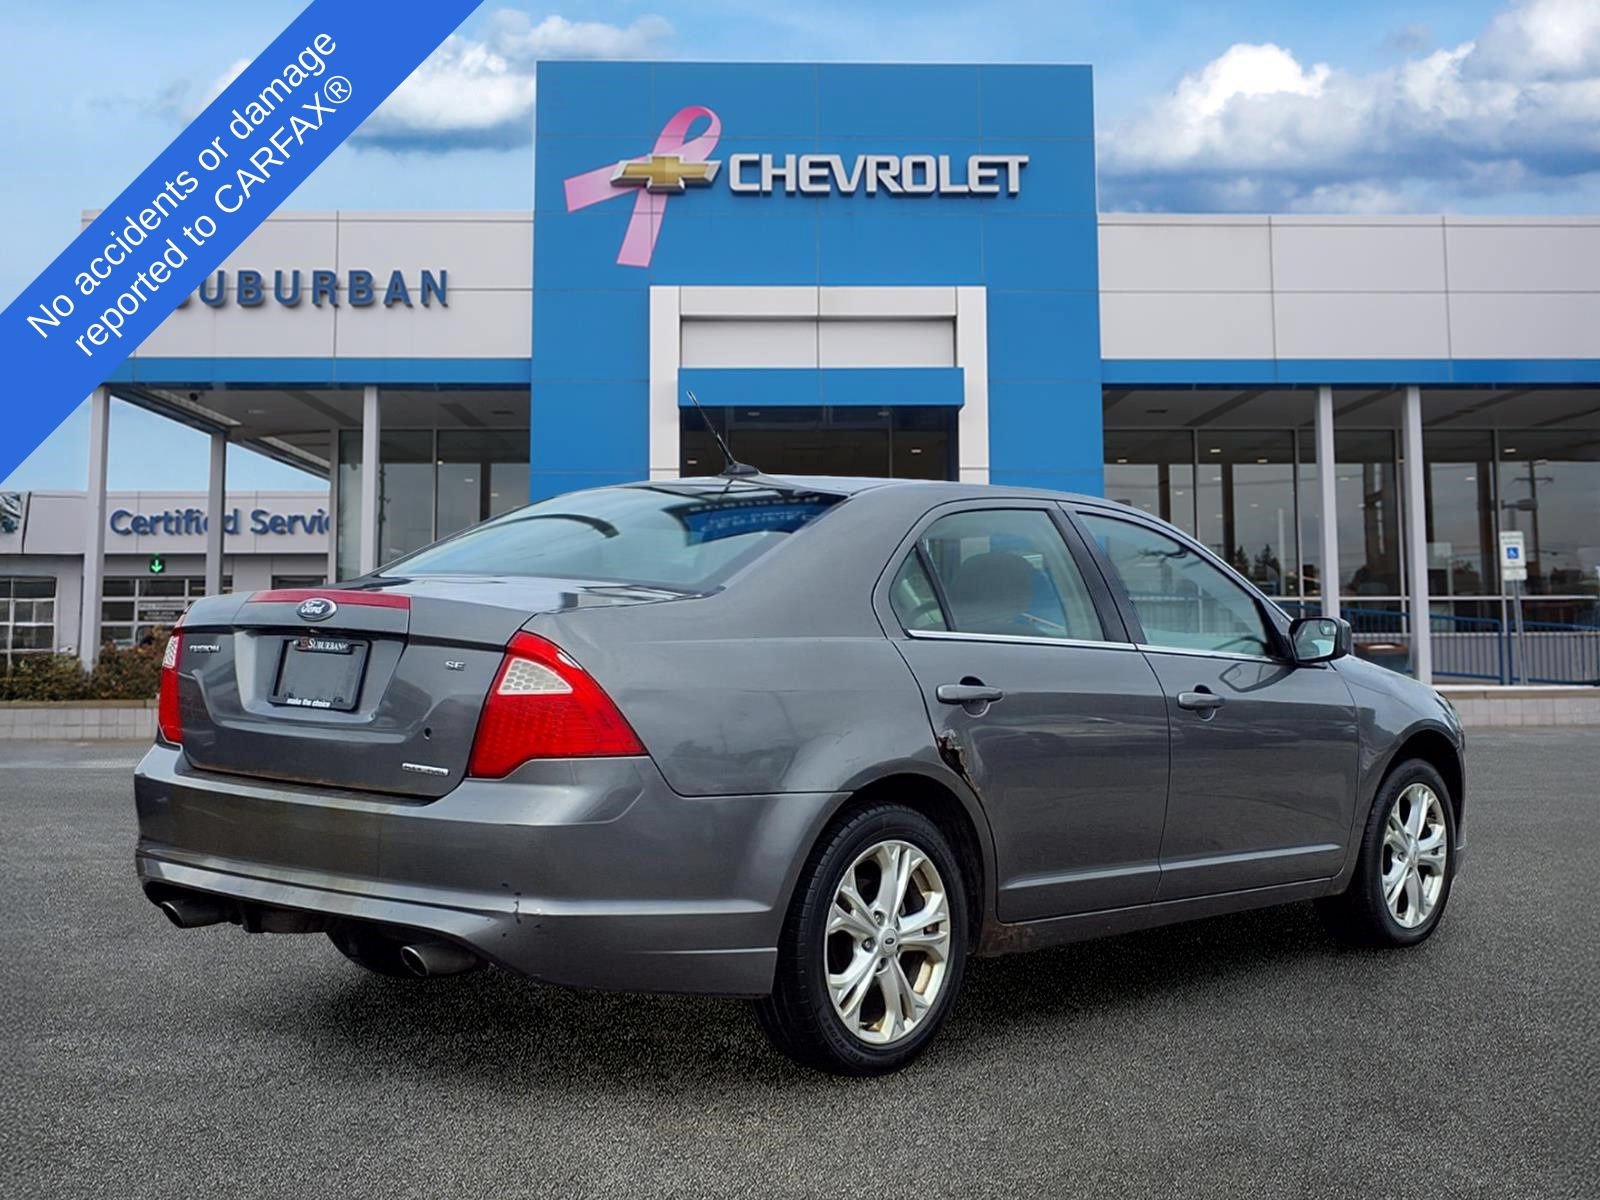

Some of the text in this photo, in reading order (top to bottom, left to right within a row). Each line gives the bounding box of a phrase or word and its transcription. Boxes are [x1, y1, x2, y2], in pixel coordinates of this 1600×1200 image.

[729, 153, 1029, 193] CHEVROLET
[178, 270, 449, 308] UBURBAN
[445, 660, 466, 671] SE
